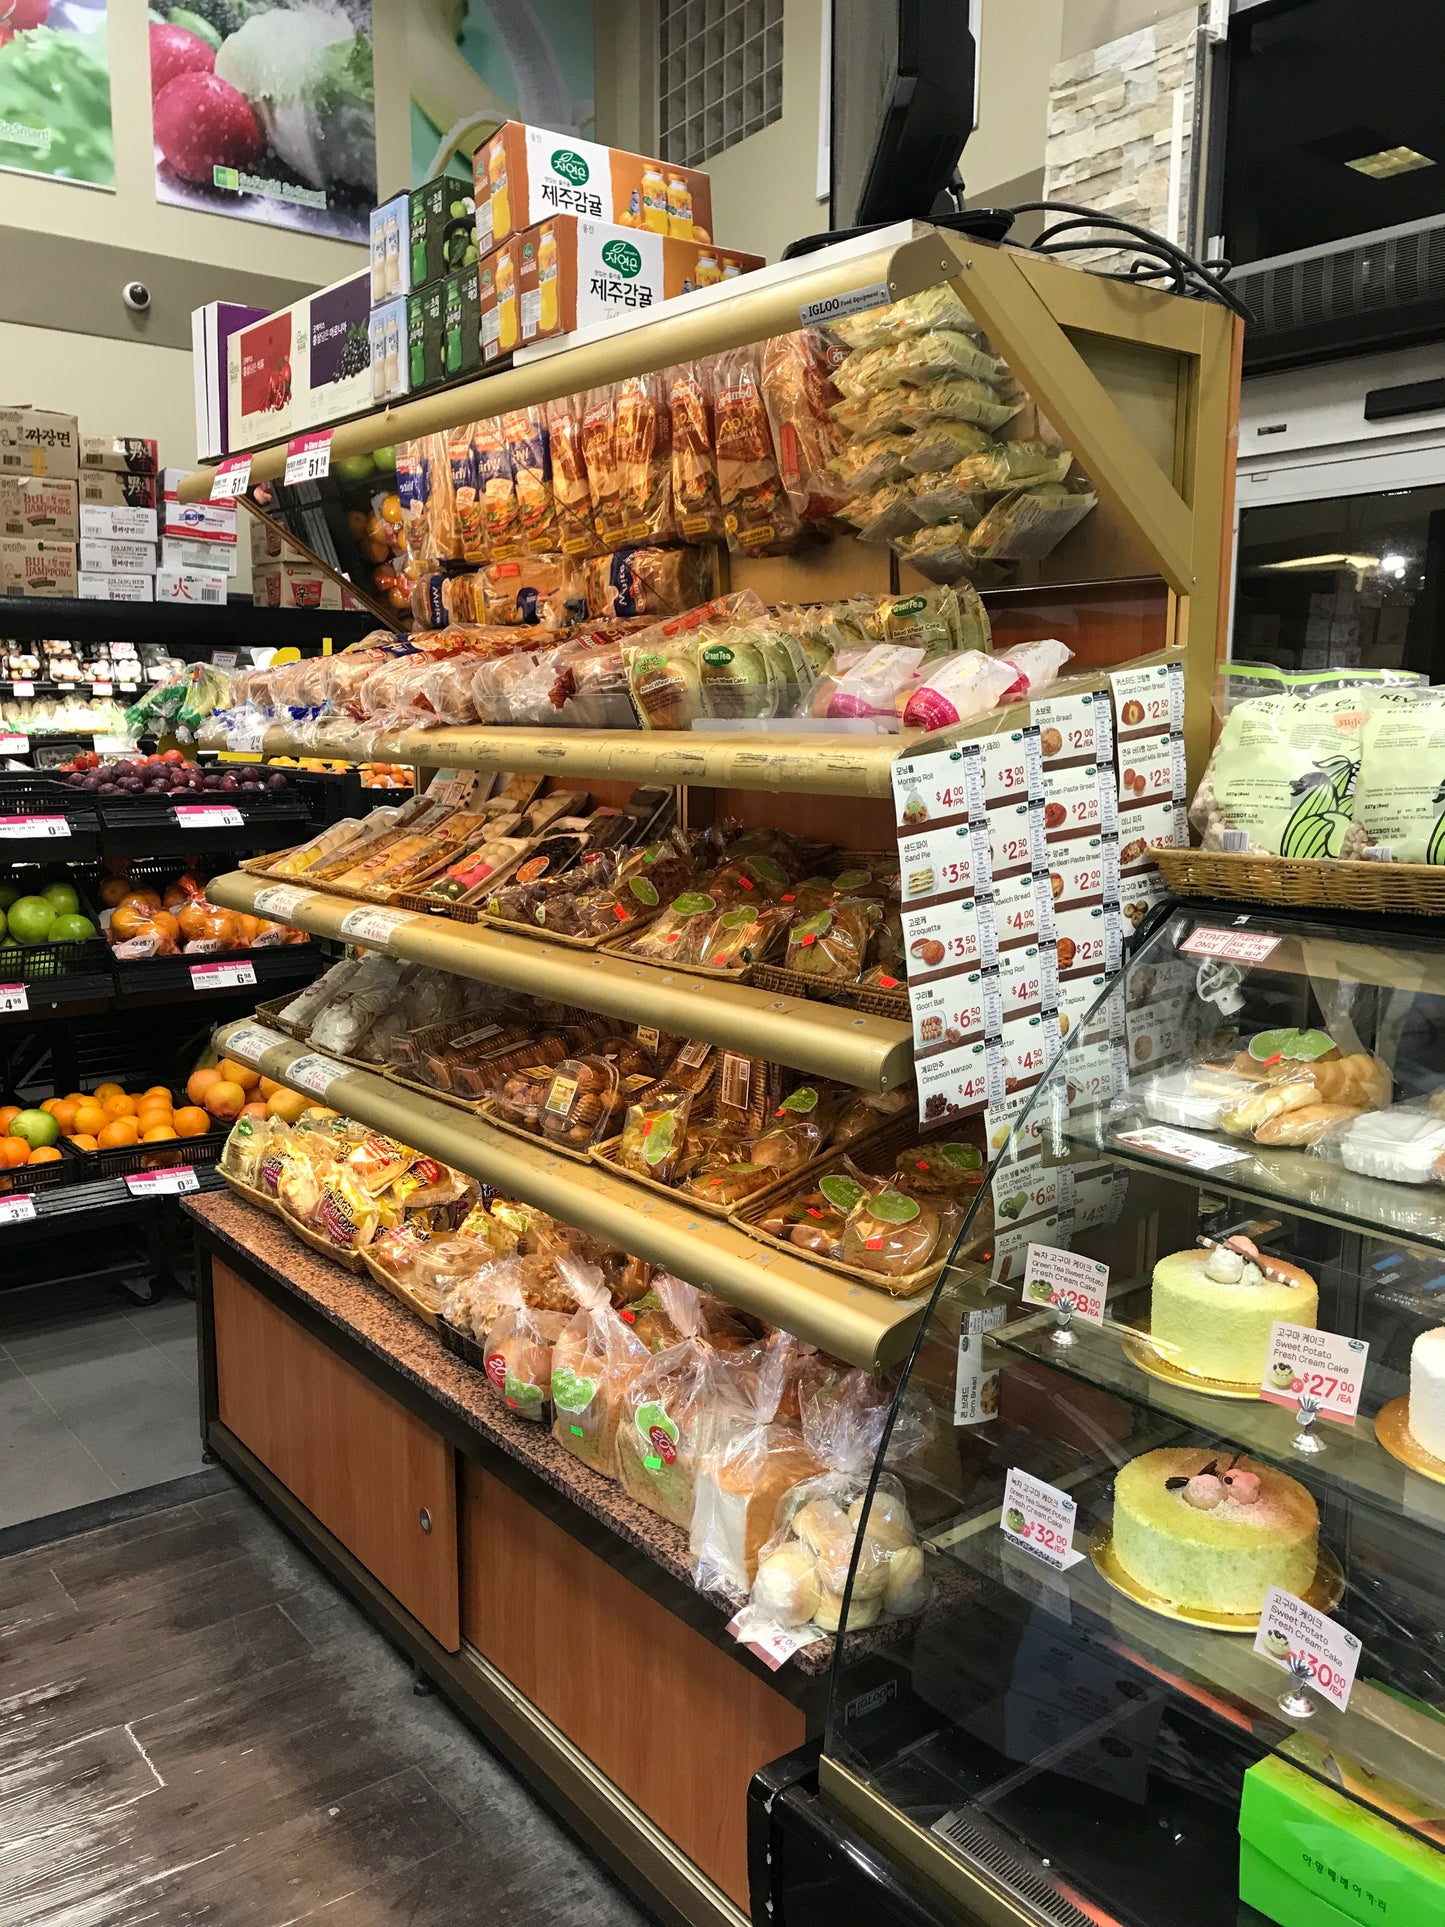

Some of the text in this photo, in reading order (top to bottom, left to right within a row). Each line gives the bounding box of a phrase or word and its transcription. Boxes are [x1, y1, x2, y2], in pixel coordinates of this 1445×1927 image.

[541, 184, 602, 217] 제주감귤
[590, 278, 653, 308] 제주감귤
[808, 298, 840, 317] IGLOO
[840, 298, 852, 307] Food
[853, 291, 879, 303] Equipment
[25, 427, 72, 449] 짜장면
[308, 458, 319, 477] 51
[231, 478, 241, 494] 51
[24, 493, 45, 505] BUL
[25, 556, 46, 567] BUL
[25, 565, 72, 578] JJAMPPONG
[171, 577, 193, 601] 火
[909, 598, 924, 609] Tea
[907, 625, 925, 635] Wheat
[925, 622, 941, 631] Cake
[704, 651, 731, 660] Green Tea
[654, 679, 670, 688] Wheat
[1152, 682, 1166, 690] Bread
[1035, 705, 1052, 716] 소보로
[1035, 713, 1073, 725] Soboro Bread
[1122, 751, 1170, 766] Condensed Bread
[897, 773, 934, 787] Morning Roll
[1063, 785, 1079, 794] Paste
[1079, 782, 1096, 791] Bread
[1121, 824, 1145, 835] Mini Pizza
[904, 851, 931, 863] Sand Pie
[1057, 852, 1101, 868] Bean Paste Bread
[1013, 892, 1031, 903] Bread
[909, 924, 942, 937] Croquette
[1194, 932, 1230, 950] STAFF ONLY
[1238, 933, 1265, 943] PLEASE
[1247, 943, 1271, 951] STAFF
[1014, 965, 1025, 973] Roll
[236, 973, 245, 984] 6
[933, 997, 945, 1006] Ball
[1065, 995, 1086, 1005] Tapioca
[1086, 1060, 1097, 1068] Red
[921, 1063, 973, 1084] Cinnamon Manzoo
[989, 1115, 1001, 1125] Soft
[177, 1180, 186, 1191] 0
[996, 1174, 1032, 1192] Soft Chestnut
[997, 1185, 1023, 1199] Green Tea
[10, 1209, 20, 1219] 3
[1033, 1249, 1092, 1273] 녹차 고구마 케이크
[1031, 1267, 1097, 1293] Fresh Cream Cake
[1032, 1260, 1105, 1288] Green Tea Sweet Potato
[1276, 1327, 1326, 1347] 고구마 케이크
[1275, 1338, 1332, 1360] Sweet Potato
[1273, 1348, 1350, 1375] Fresh Cream Cake
[970, 1376, 978, 1398] Bread
[1022, 1482, 1059, 1509] 고구마 케이크
[1008, 1494, 1064, 1530] Fresh Cream Cake
[1009, 1487, 1071, 1524] Green Tea Sweet Potato
[1273, 1593, 1323, 1631] 고구마 케이크
[1270, 1604, 1329, 1646] Sweet Potato
[1268, 1614, 1343, 1668] Fresh Cream Cake
